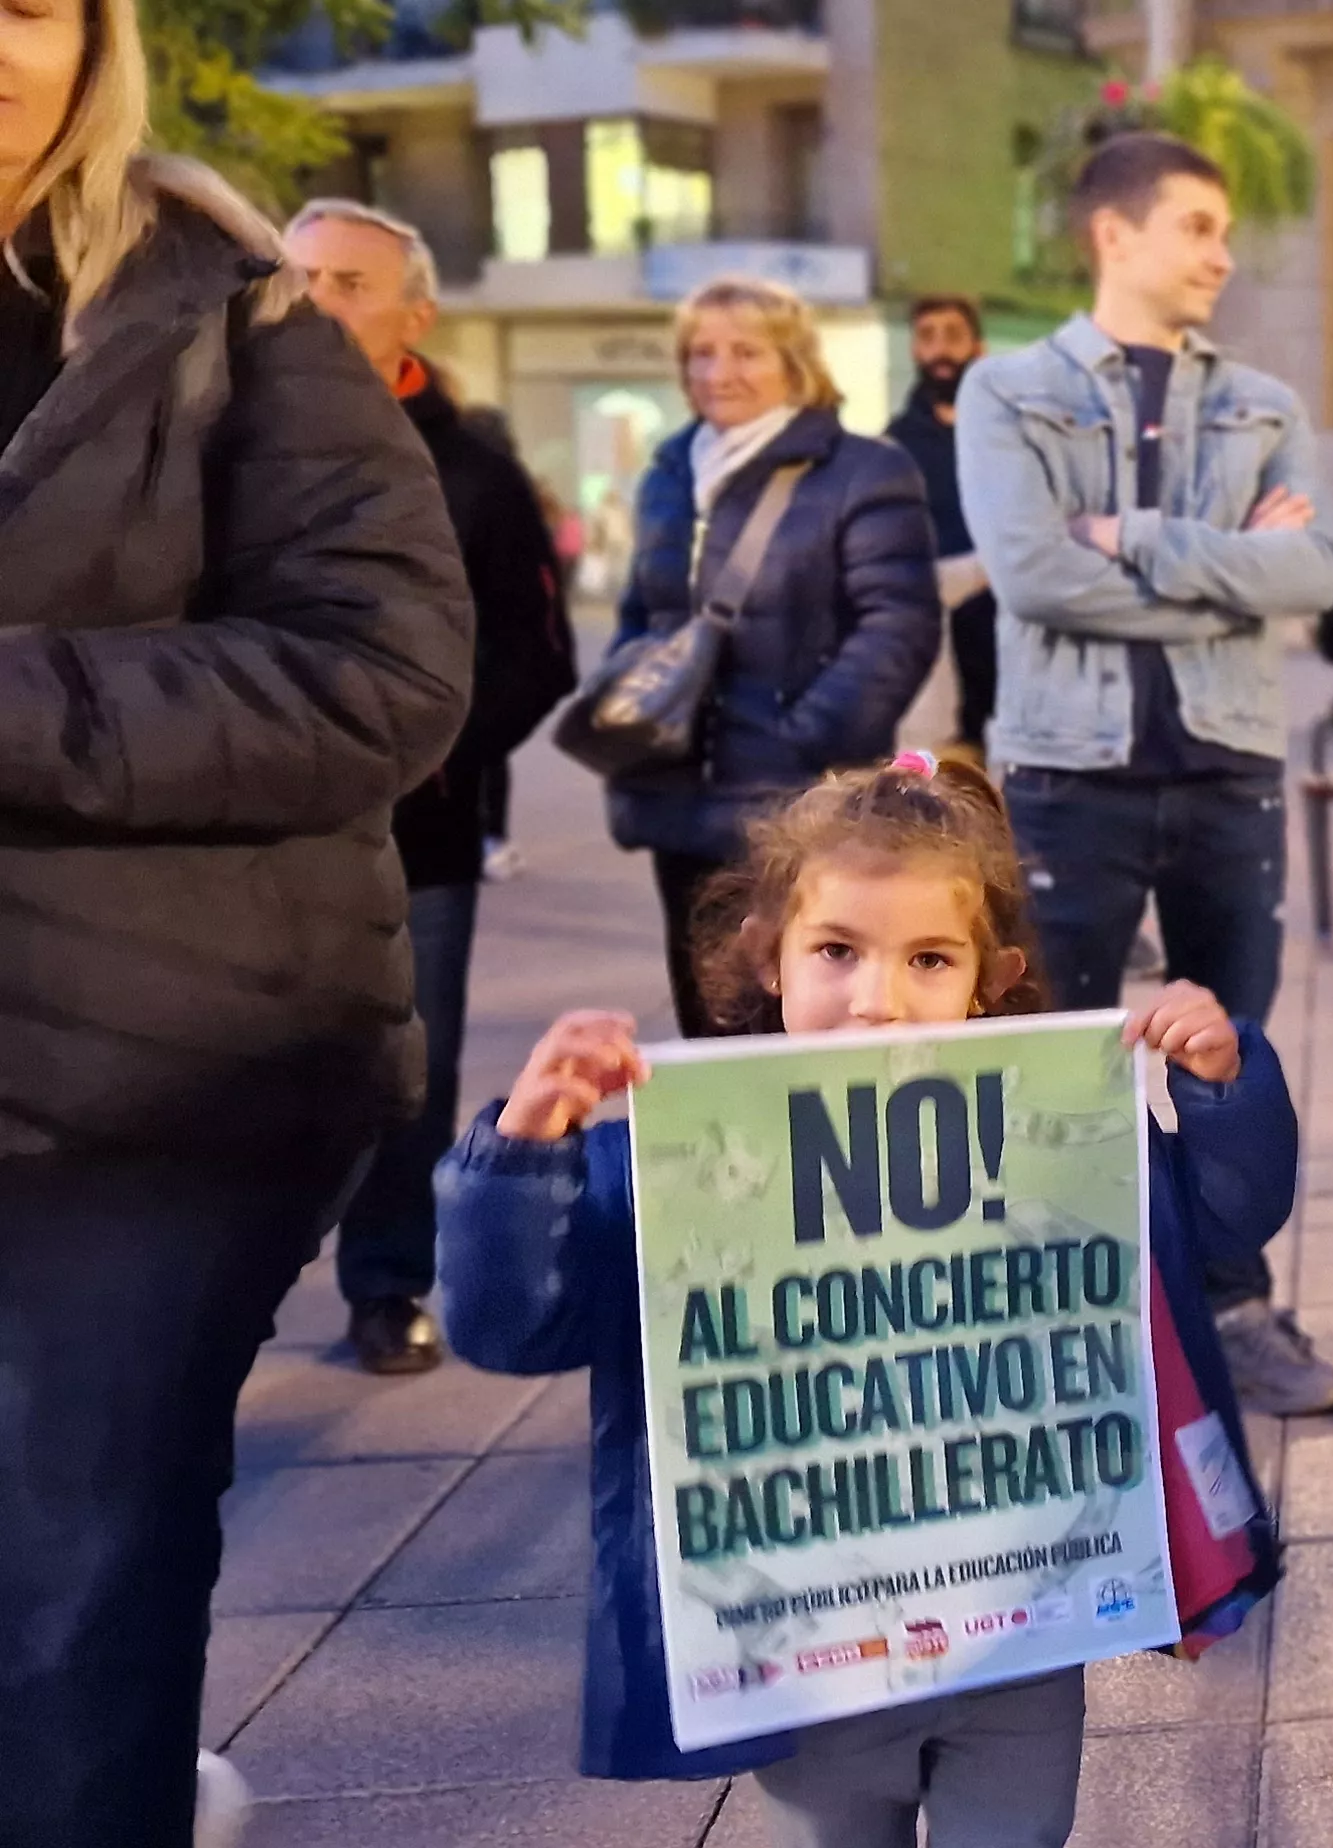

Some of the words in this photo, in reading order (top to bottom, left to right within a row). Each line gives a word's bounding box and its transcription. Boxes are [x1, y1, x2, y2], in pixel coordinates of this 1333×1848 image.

[788, 1073, 1006, 1244] NO!
[679, 1286, 758, 1367] AL
[772, 1236, 1121, 1350] CONCIERTO
[682, 1335, 1051, 1461] EDUCATIVO
[1051, 1321, 1127, 1402] EN
[675, 1412, 1138, 1560] BACHILLERATO
[873, 1569, 921, 1600] PARA
[924, 1565, 946, 1590] LA
[950, 1545, 1048, 1584] EDUCACIÓN
